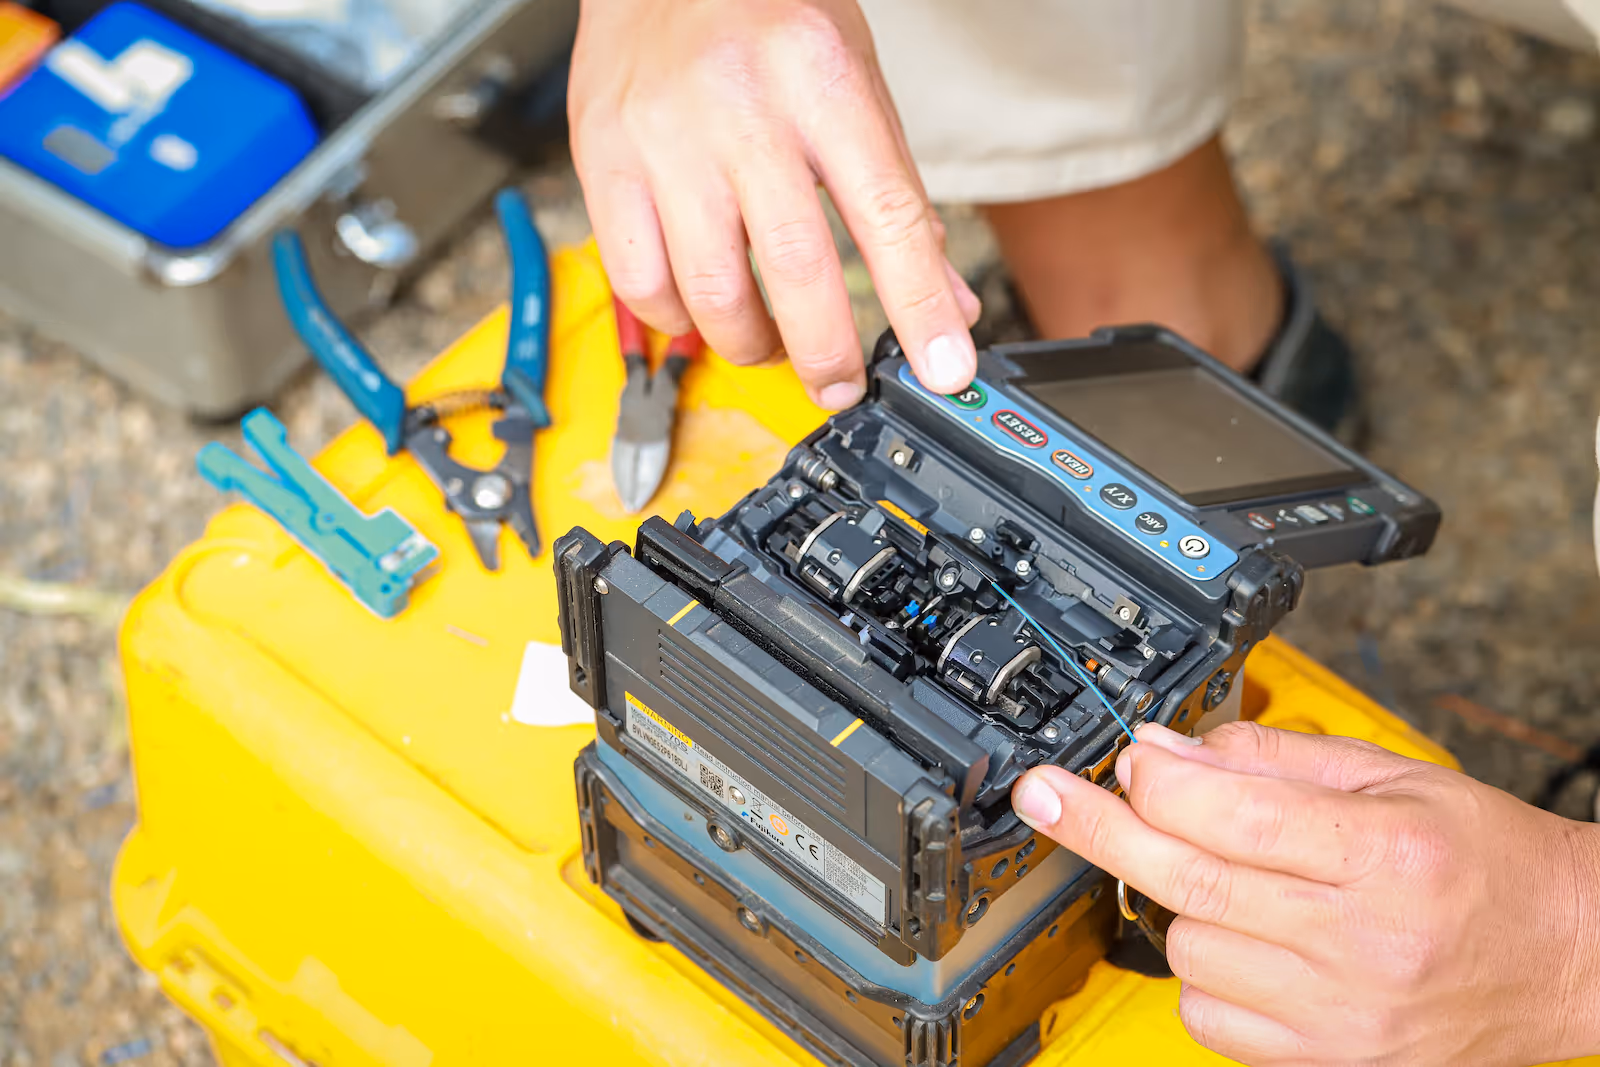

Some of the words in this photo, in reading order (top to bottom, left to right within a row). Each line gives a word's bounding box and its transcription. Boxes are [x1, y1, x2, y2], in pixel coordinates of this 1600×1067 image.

[960, 391, 980, 402] S
[997, 413, 1045, 444] RESET
[1056, 453, 1089, 474] HEAT
[1104, 486, 1134, 504] X/Y
[1139, 513, 1165, 529] ARC
[641, 703, 690, 745] WARNING
[668, 732, 688, 752] 70S
[694, 743, 713, 762] Read
[715, 759, 752, 790] instruction
[753, 788, 781, 812] manual
[782, 808, 806, 831] before
[750, 816, 785, 846] Fujikura
[795, 834, 819, 861] CE
